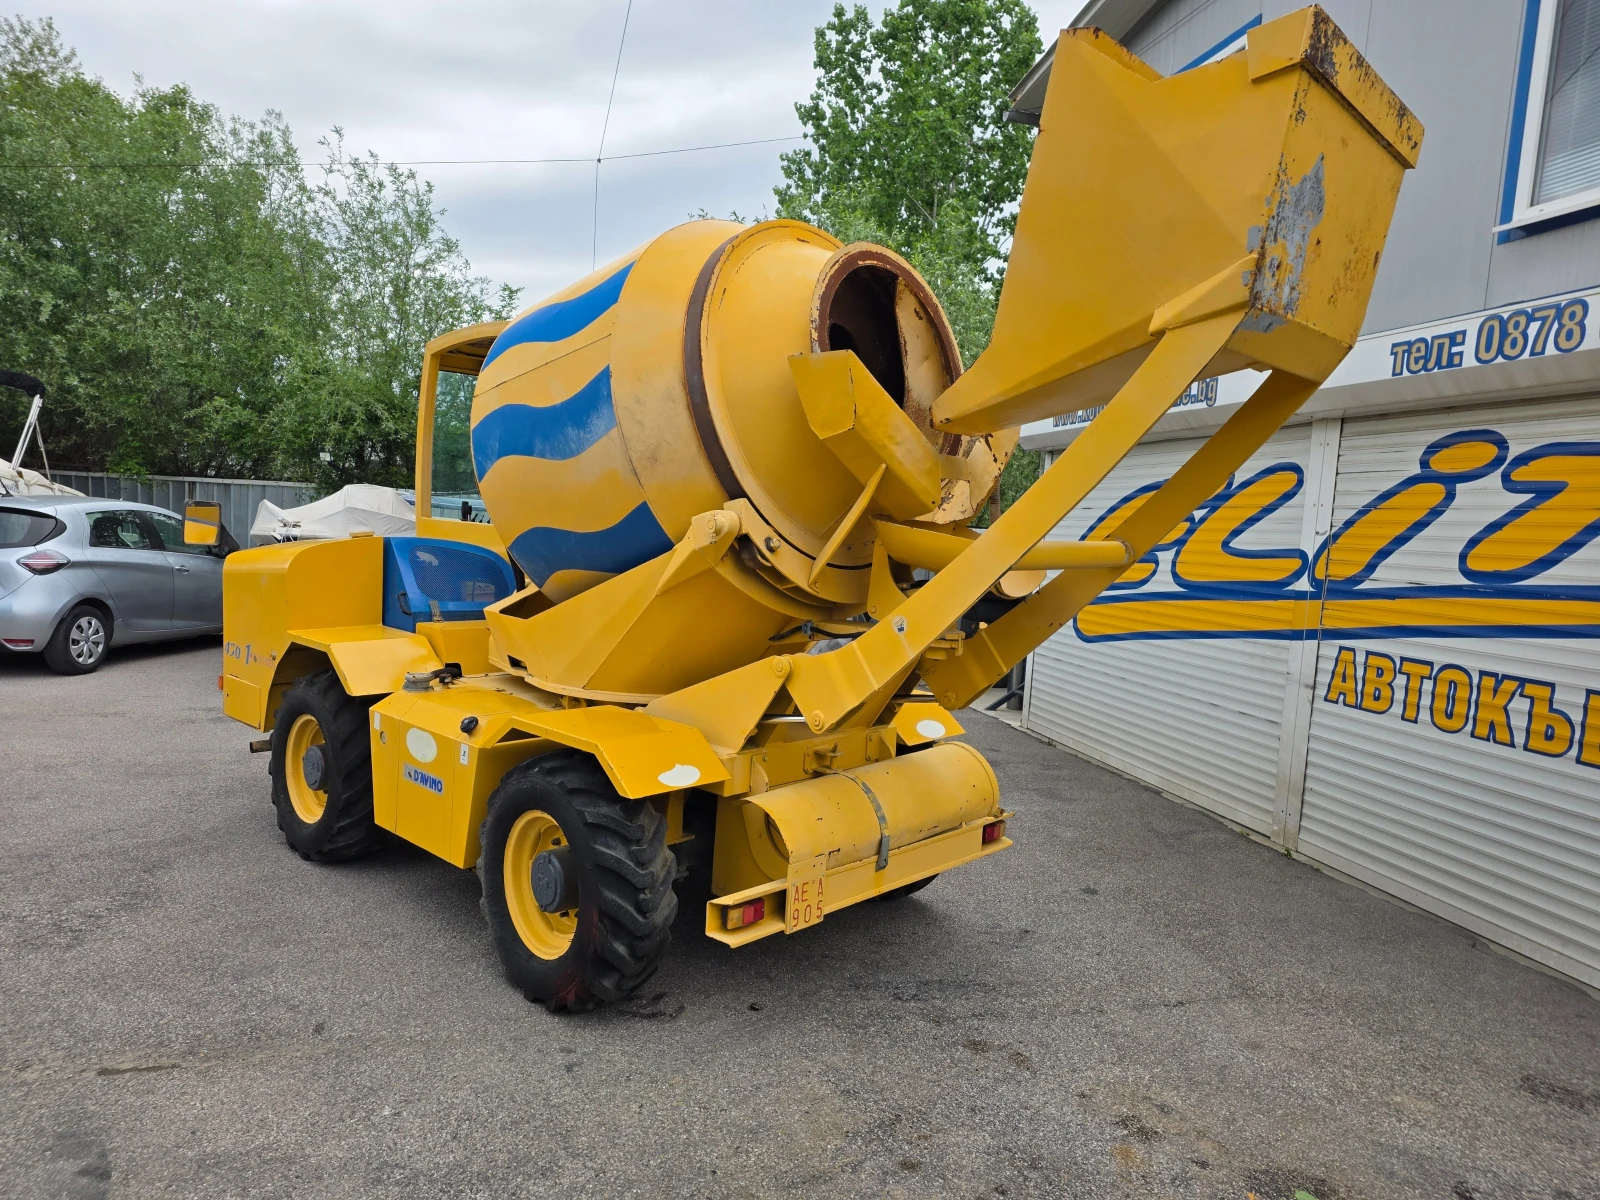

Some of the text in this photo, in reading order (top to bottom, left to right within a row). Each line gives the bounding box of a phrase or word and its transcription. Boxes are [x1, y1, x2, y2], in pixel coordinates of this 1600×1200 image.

[1390, 298, 1589, 377] тел: 0878
[793, 877, 824, 904] AE A
[792, 899, 823, 928] 905
